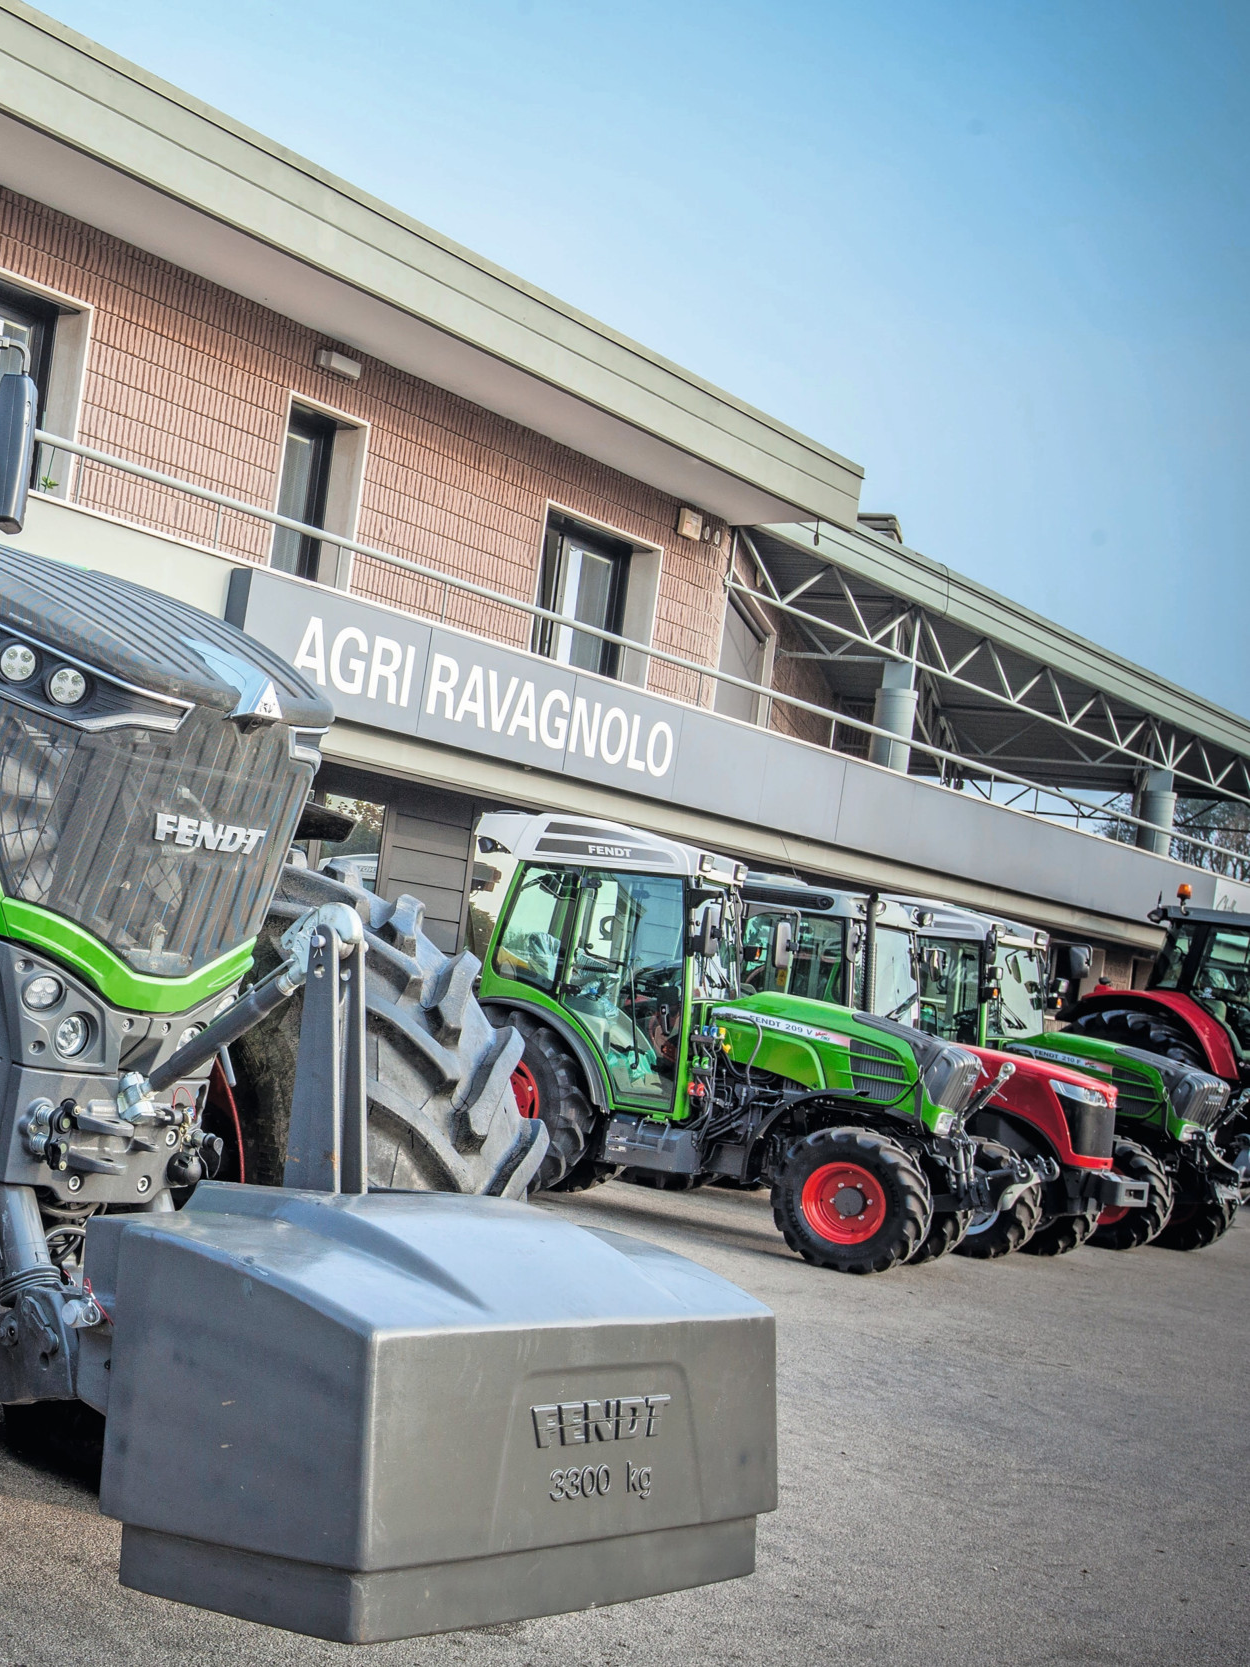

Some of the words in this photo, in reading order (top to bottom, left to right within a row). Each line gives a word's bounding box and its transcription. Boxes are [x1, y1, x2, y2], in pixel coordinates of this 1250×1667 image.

[293, 616, 415, 707] AGRI
[425, 652, 673, 777] RAVAGNOLO
[153, 812, 267, 855] FENDT
[588, 844, 632, 858] FENDT
[785, 1023, 803, 1033] 209
[806, 1028, 813, 1036] V
[1034, 1049, 1059, 1060] FENDT
[1061, 1055, 1075, 1063] 210
[530, 1394, 671, 1448] FENDT
[549, 1463, 610, 1502] 3300
[625, 1460, 652, 1500] kg
